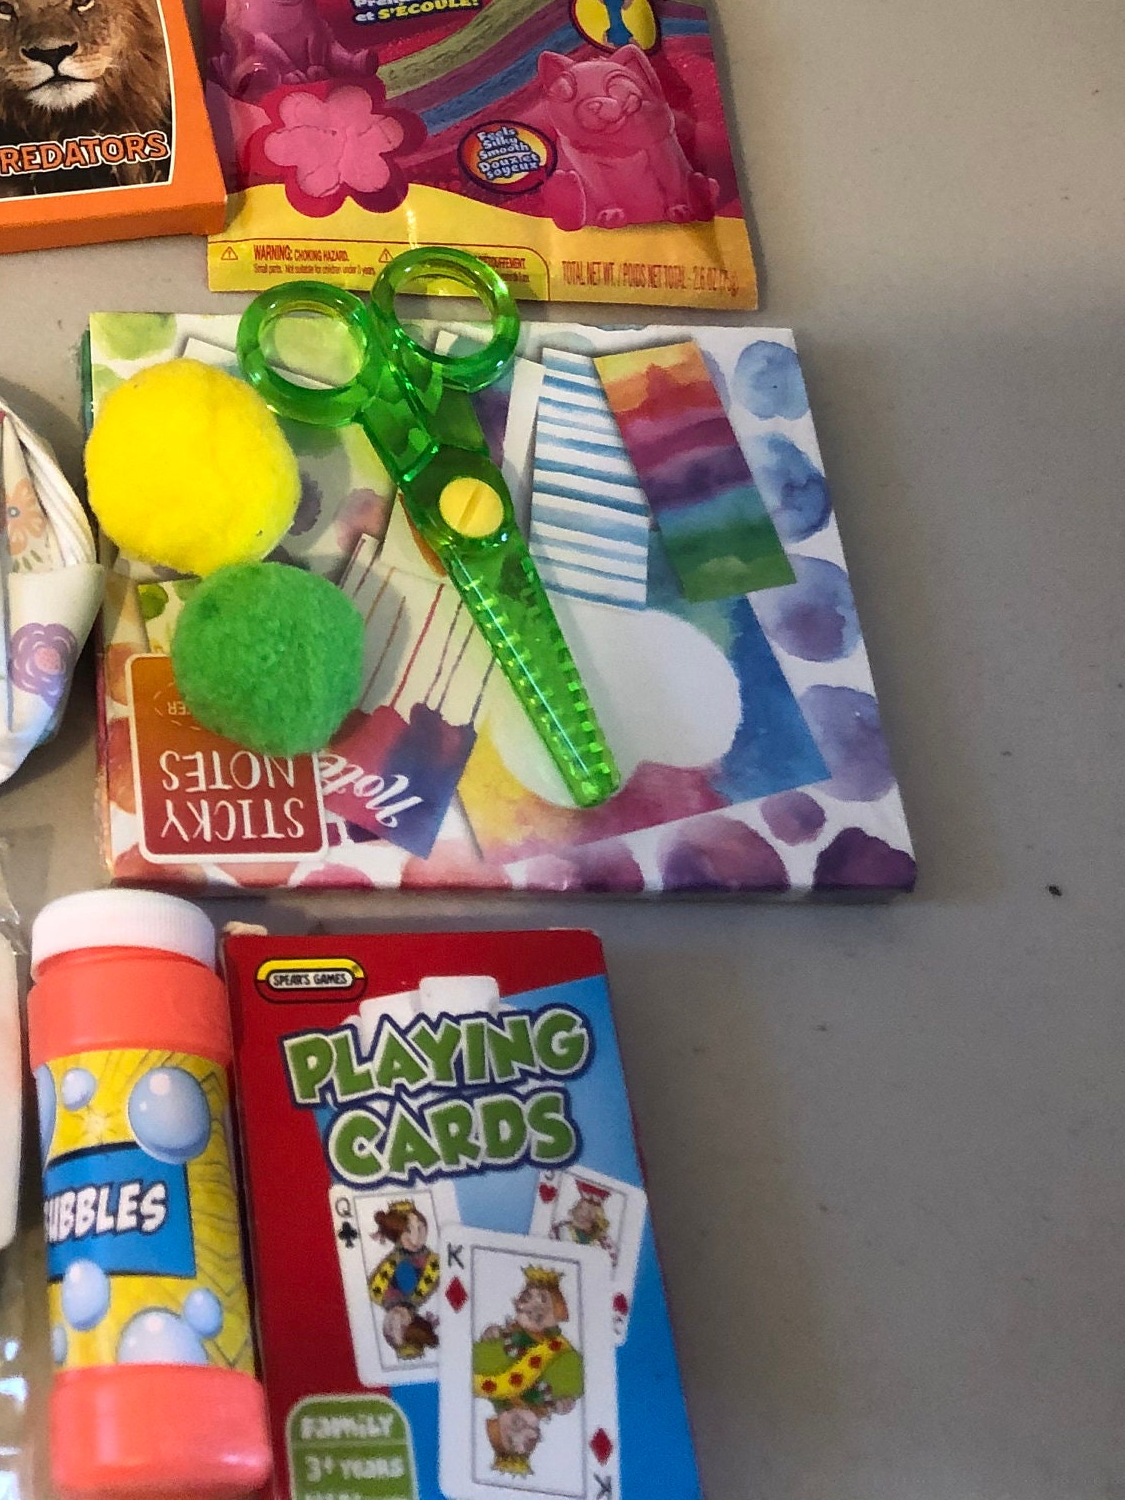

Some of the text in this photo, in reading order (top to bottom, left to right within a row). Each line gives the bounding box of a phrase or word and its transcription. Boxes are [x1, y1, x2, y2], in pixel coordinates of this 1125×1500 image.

[355, 11, 375, 23] et
[477, 127, 515, 140] Feels
[483, 136, 518, 149] Silky
[479, 142, 529, 159] Smooth
[478, 156, 520, 172] Doux
[253, 245, 292, 261] WARNING:
[159, 751, 295, 792] NOTES
[161, 799, 305, 842] STICKY
[273, 974, 348, 986] SPEAR'S GAMES
[283, 1008, 590, 1104] PLAYING
[328, 1092, 577, 1185] CARDS
[44, 1183, 167, 1243] UBBLES
[336, 1198, 352, 1218] Q
[448, 1244, 465, 1269] K
